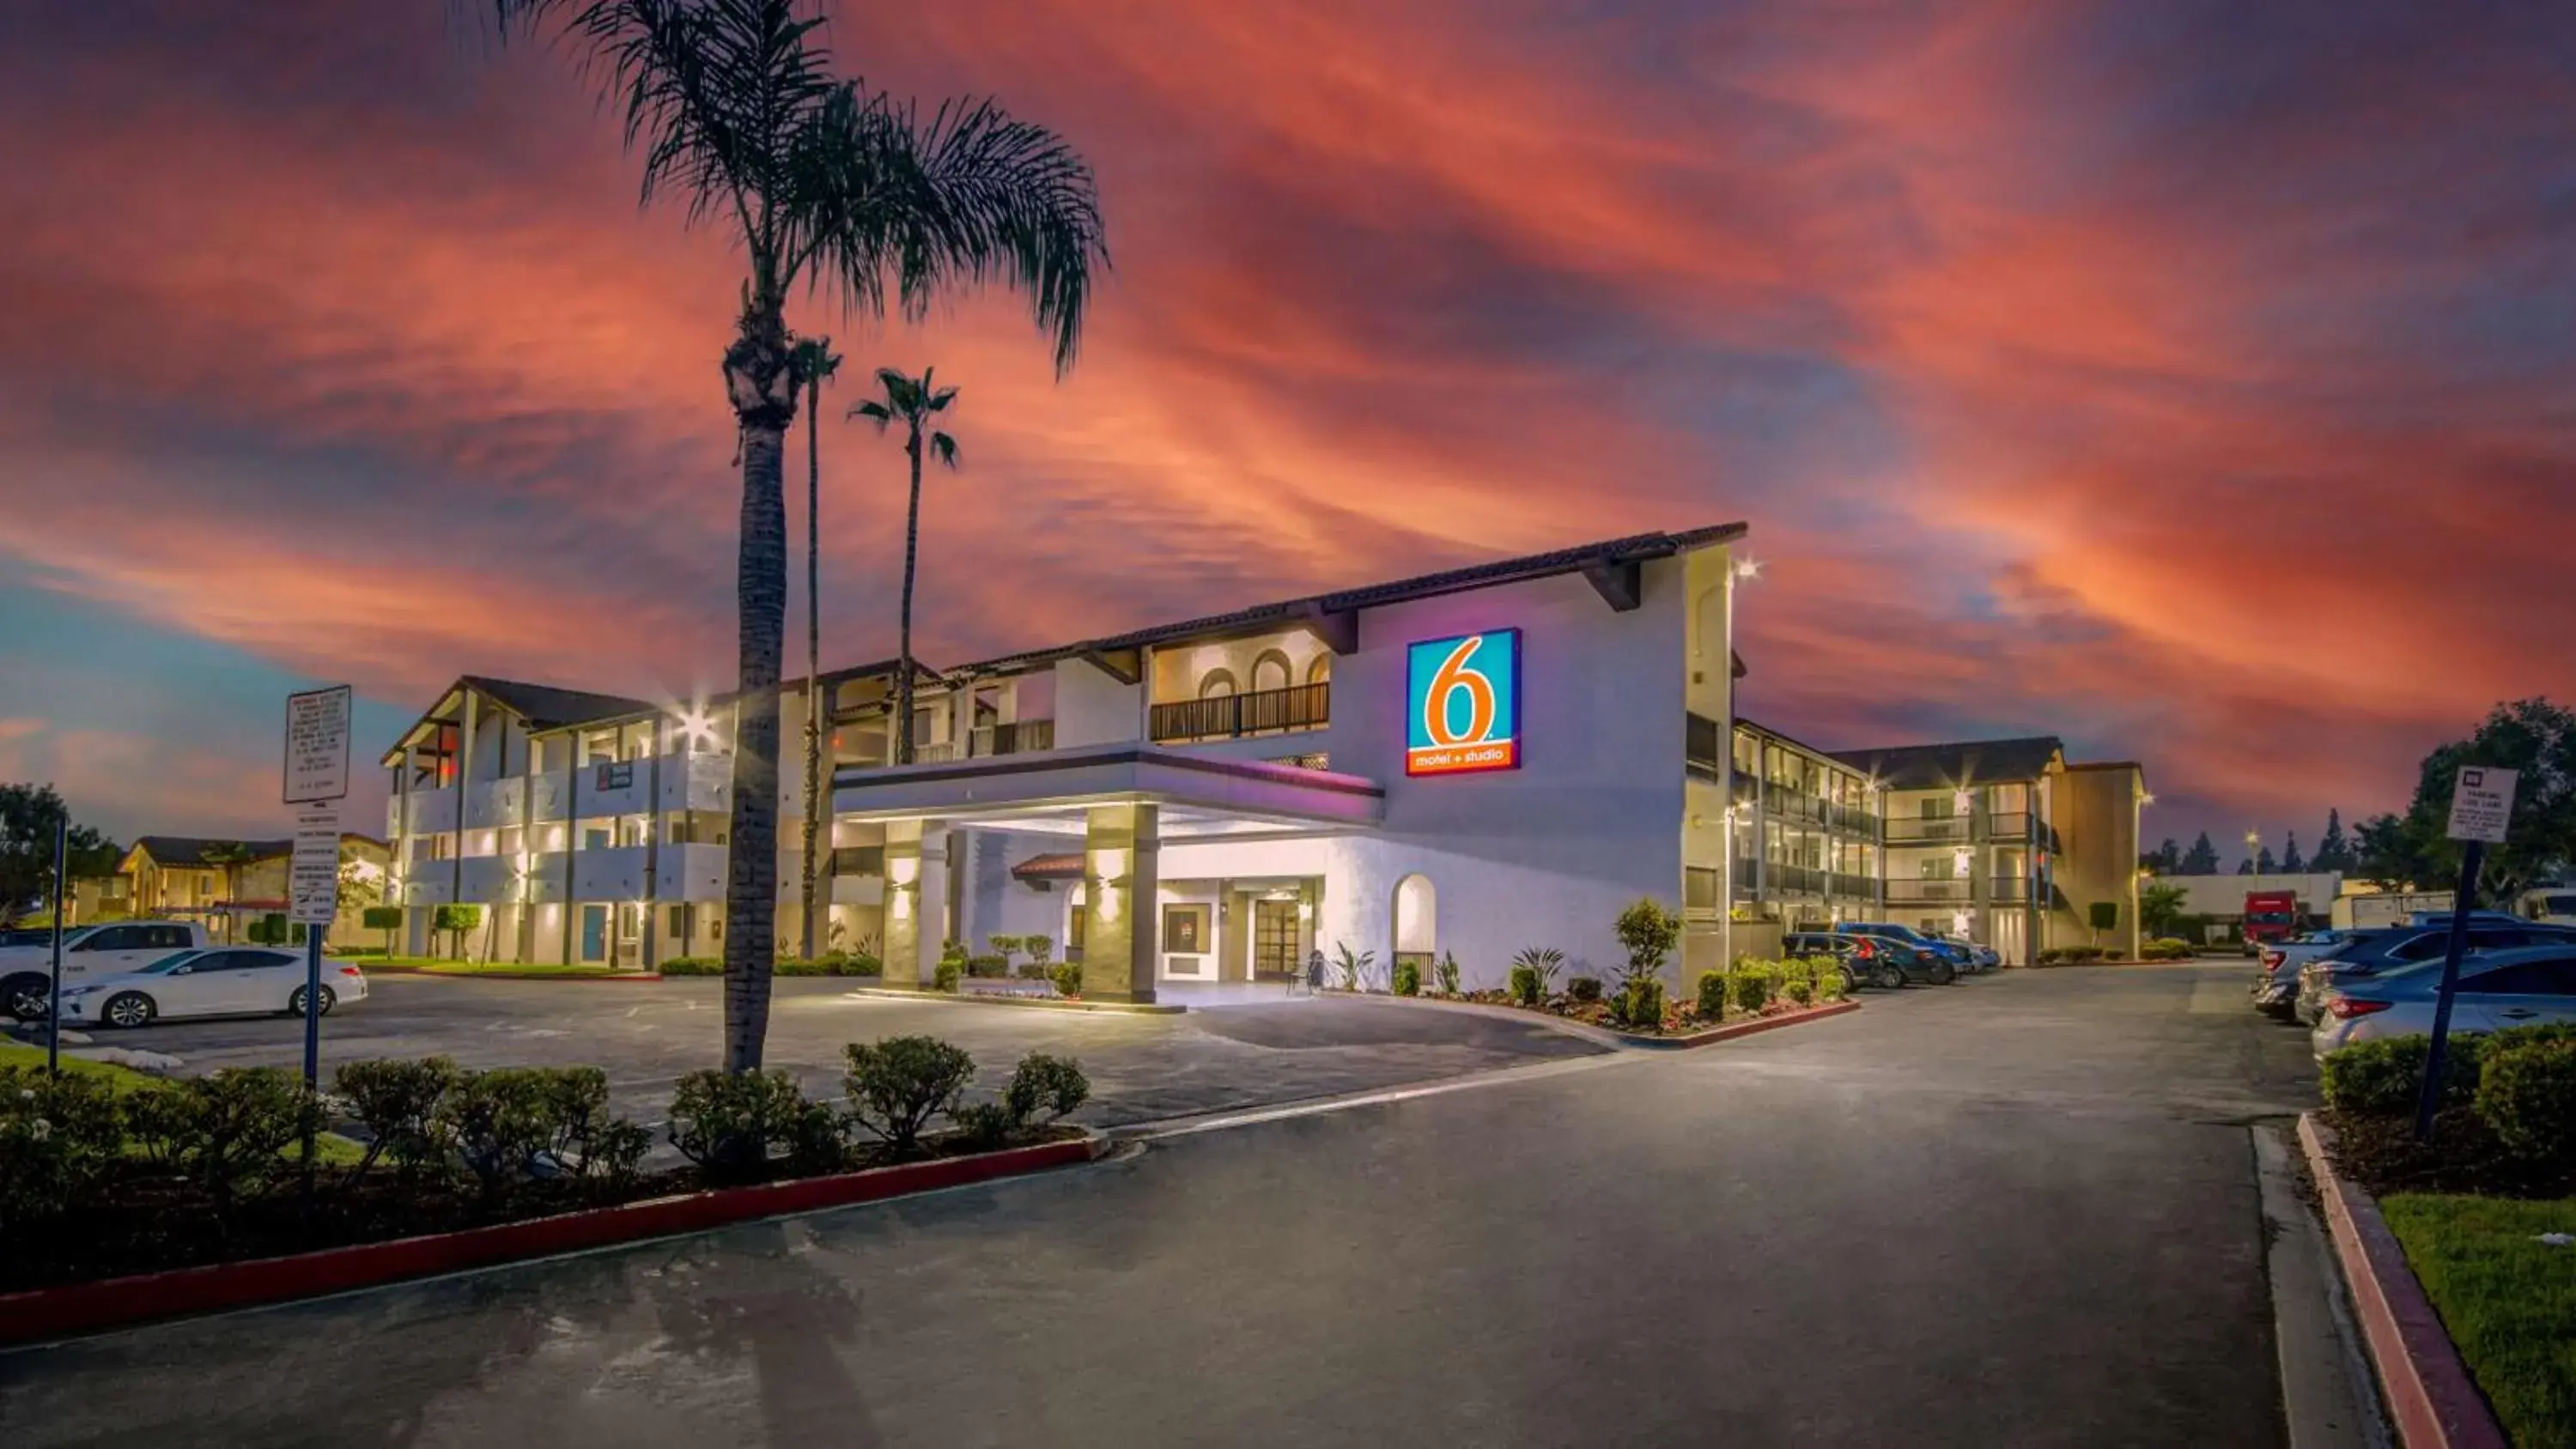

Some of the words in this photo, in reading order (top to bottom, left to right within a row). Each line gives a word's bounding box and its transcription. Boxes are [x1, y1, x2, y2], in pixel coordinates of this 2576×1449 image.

[1424, 636, 1496, 747] 6
[1415, 751, 1451, 767] motel
[1465, 749, 1504, 763] studio
